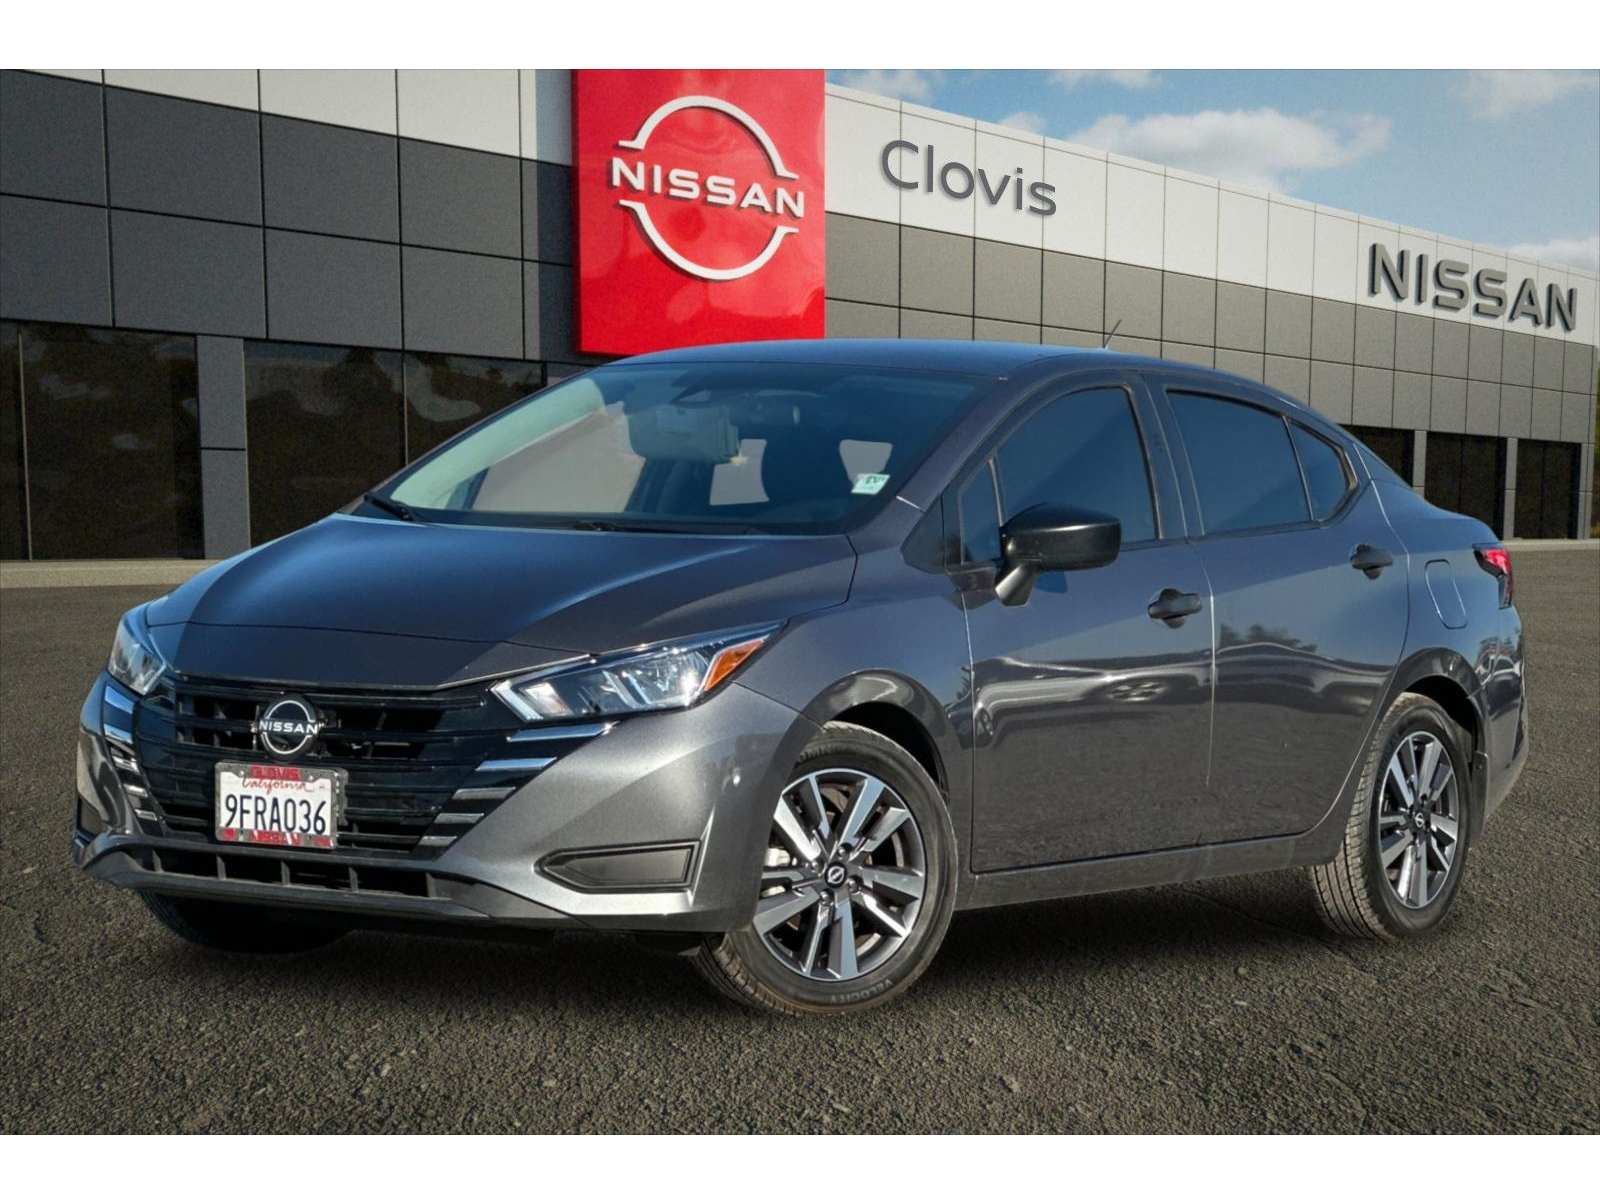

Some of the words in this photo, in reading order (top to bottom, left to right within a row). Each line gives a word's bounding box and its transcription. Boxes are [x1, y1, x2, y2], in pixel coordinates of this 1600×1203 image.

[611, 156, 805, 218] NISSAN
[882, 139, 1057, 216] Clovis
[1368, 242, 1578, 332] NISSAN
[259, 719, 318, 735] NISSAN
[241, 776, 307, 795] California
[225, 793, 327, 835] 9FRA036
